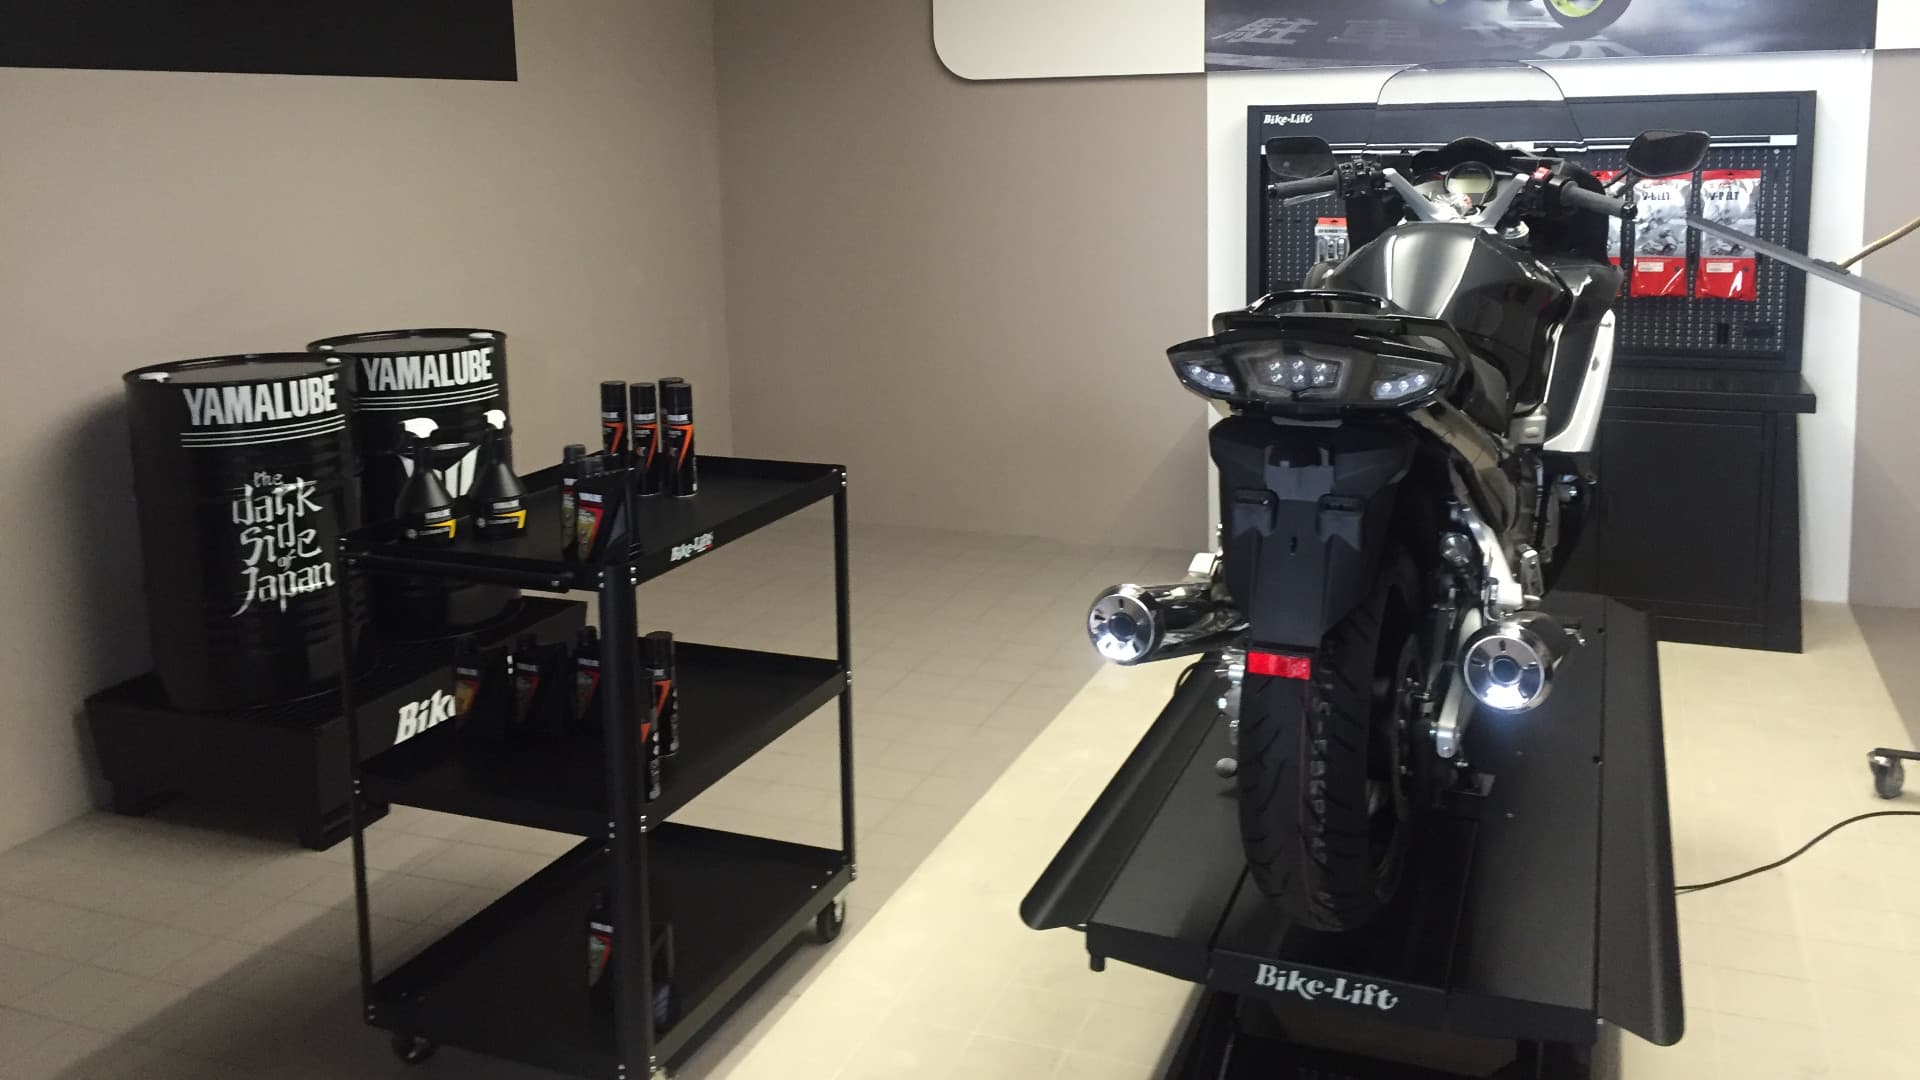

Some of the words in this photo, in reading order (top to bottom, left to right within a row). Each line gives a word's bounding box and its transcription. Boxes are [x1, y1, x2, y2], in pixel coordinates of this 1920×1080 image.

[1263, 113, 1312, 126] Bike-Lift
[361, 347, 494, 391] YAMALUBE
[183, 373, 339, 426] YAMALUBE
[232, 477, 323, 526] dark
[253, 471, 283, 488] the
[277, 549, 297, 571] of
[231, 561, 336, 618] Japan
[1255, 963, 1399, 1010] Bike-Lift
